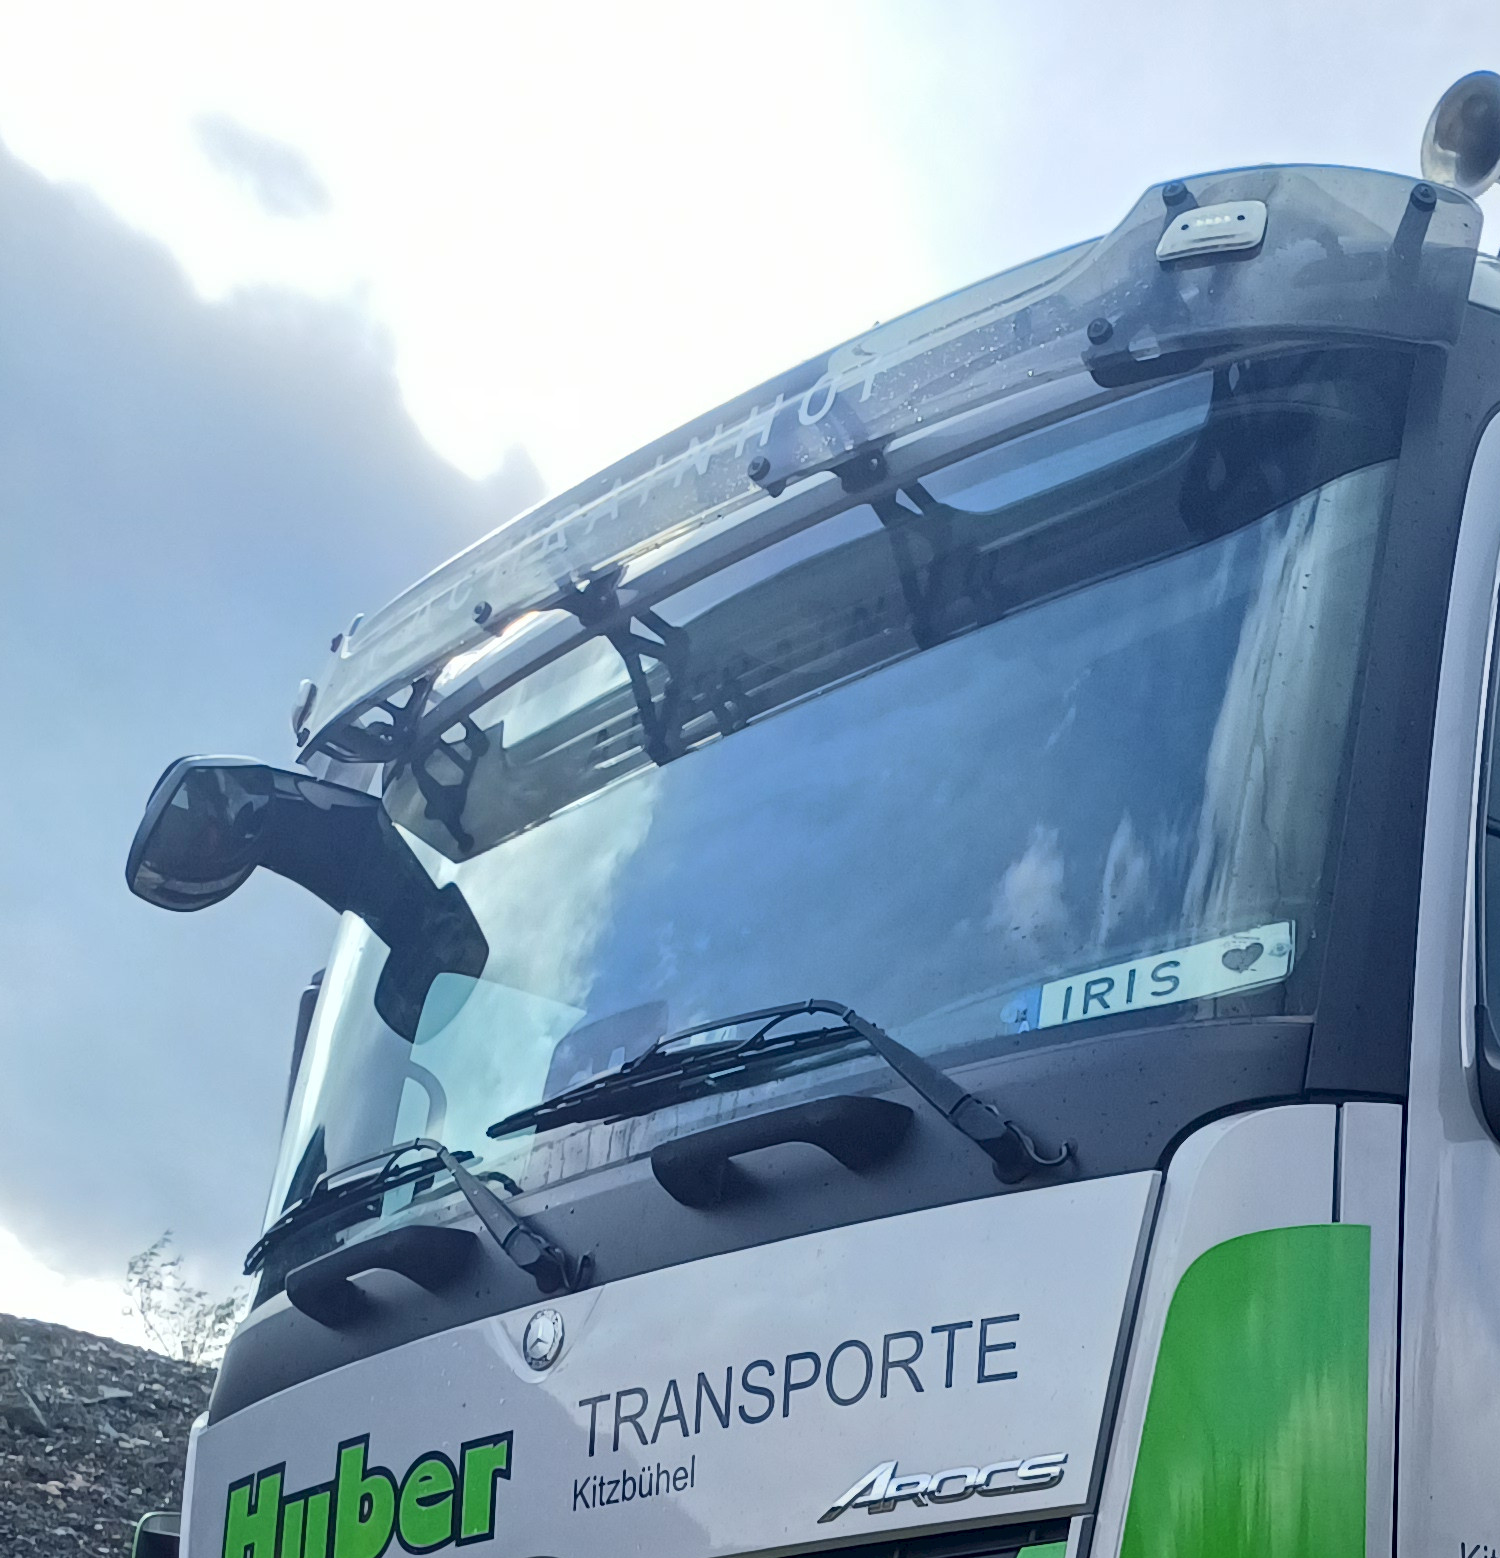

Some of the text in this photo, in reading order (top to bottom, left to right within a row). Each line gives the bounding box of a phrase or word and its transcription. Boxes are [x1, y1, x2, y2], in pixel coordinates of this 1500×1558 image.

[1061, 960, 1181, 1021] IRIS
[577, 1314, 1020, 1458] TRANSPORTE
[572, 1456, 697, 1512] Kitzbühel
